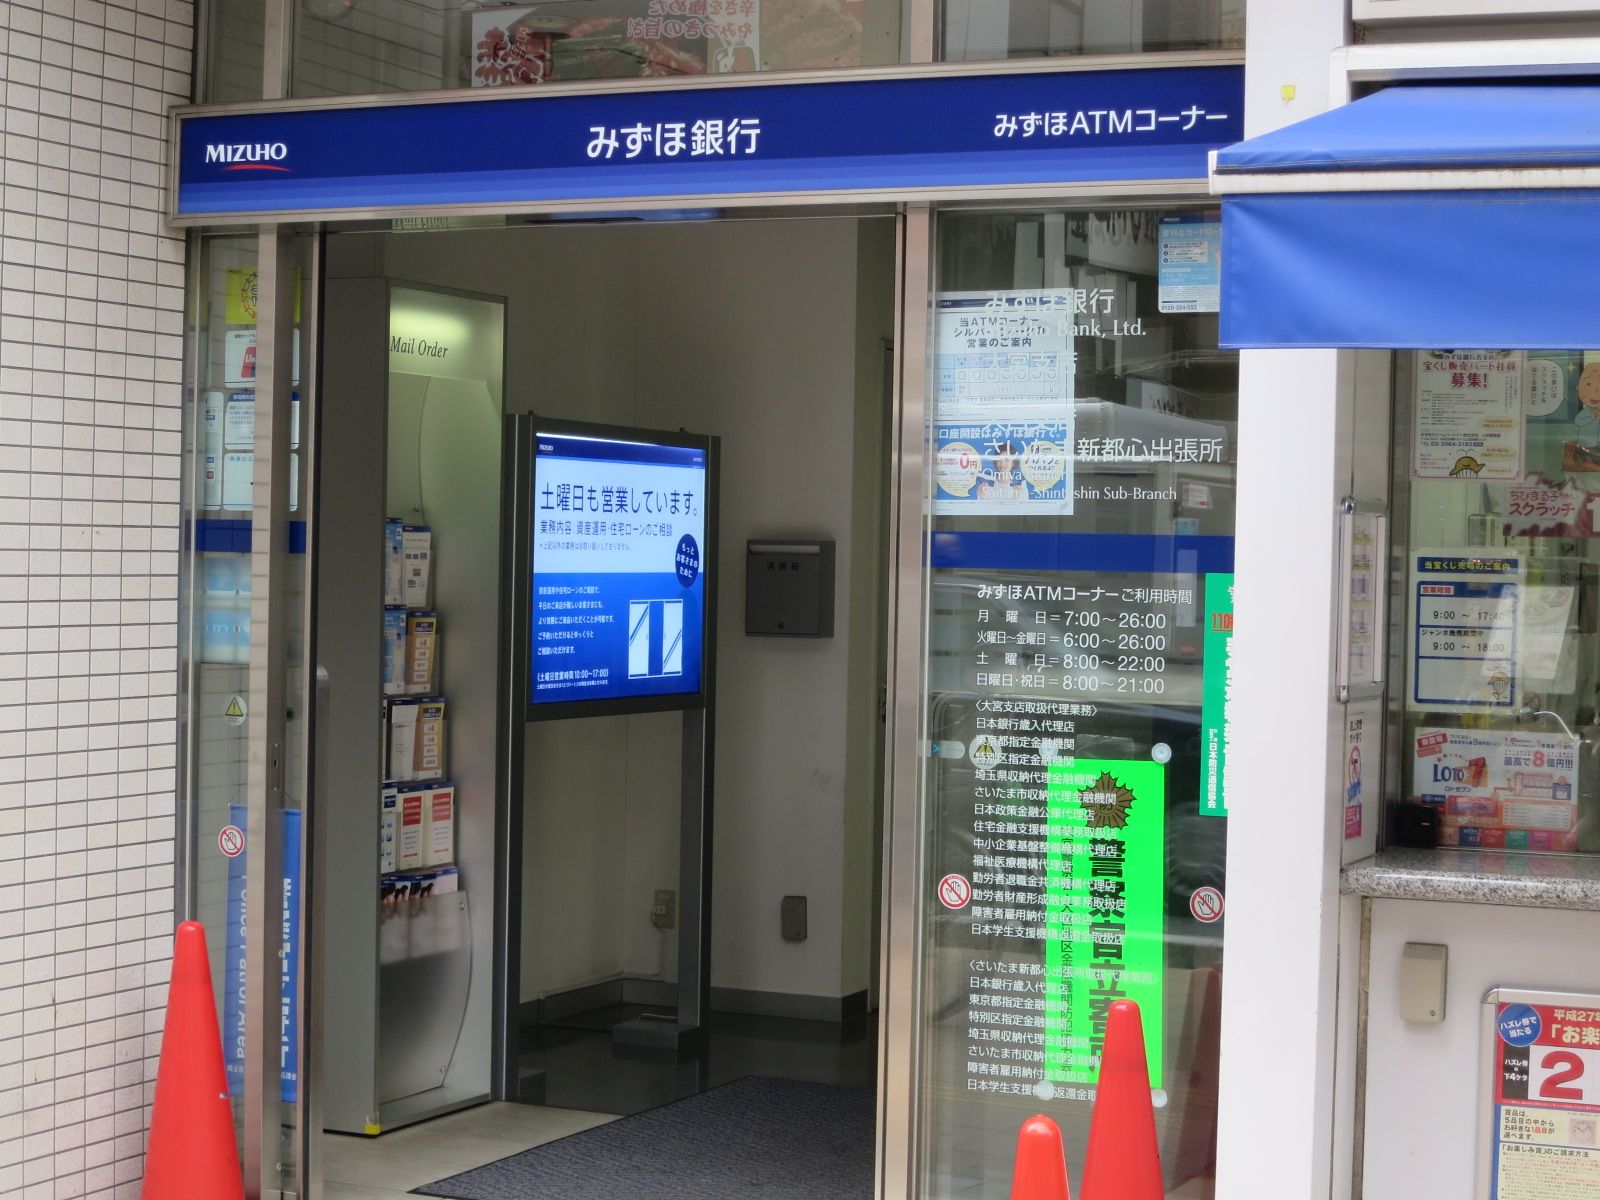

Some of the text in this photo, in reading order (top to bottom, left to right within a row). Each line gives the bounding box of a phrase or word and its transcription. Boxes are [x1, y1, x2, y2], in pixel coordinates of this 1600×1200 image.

[994, 105, 1228, 137] みずほATMコーナー
[587, 118, 760, 158] みずほ銀行
[205, 143, 287, 163] MIZUHO
[1113, 318, 1147, 337] Ltd.
[390, 336, 449, 359] Mail Order
[966, 337, 1032, 349] 営業のご案内
[540, 482, 697, 517] 土曜日も営業しています。
[1103, 486, 1177, 500] Sub-Branch
[1508, 502, 1575, 517] スクラッチ
[977, 584, 1192, 605] みずほATMコーナーご利用時間
[1433, 610, 1456, 620] 9:00
[1432, 642, 1456, 651] 9:00
[976, 717, 1075, 733] 日本銀行歳入代理店
[1433, 763, 1465, 783] LOTO
[1539, 1050, 1584, 1099] 2
